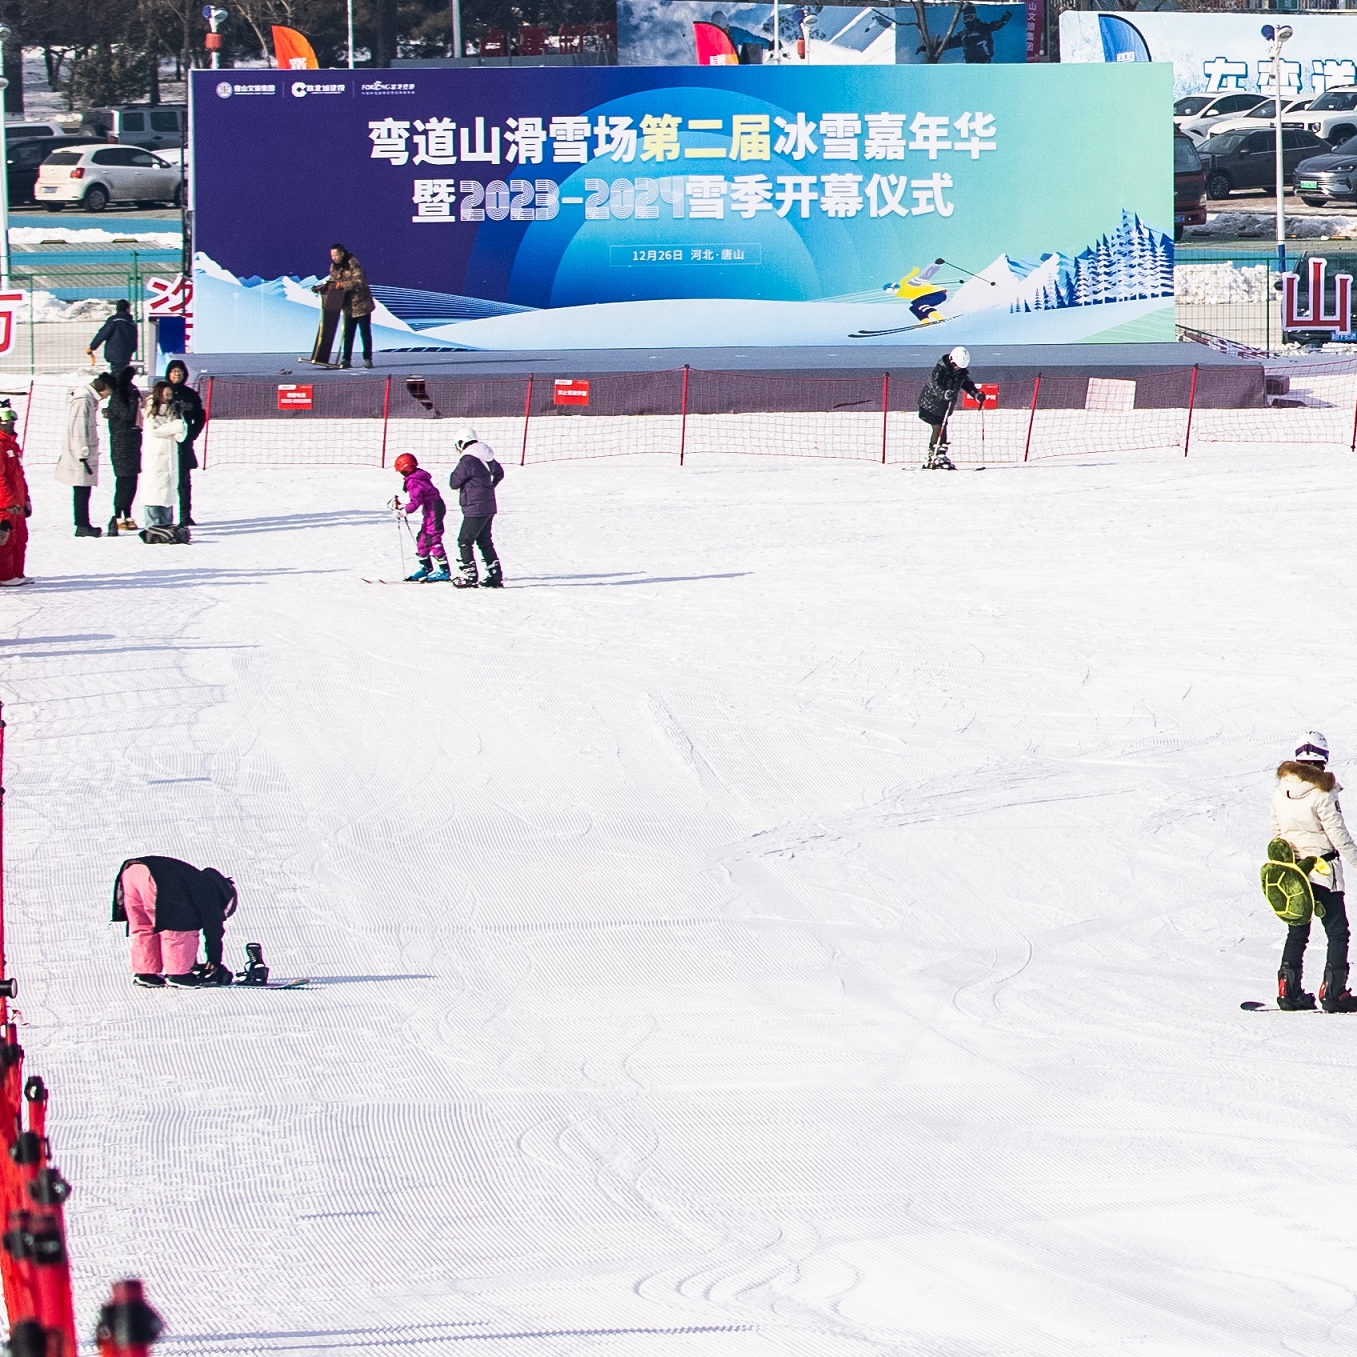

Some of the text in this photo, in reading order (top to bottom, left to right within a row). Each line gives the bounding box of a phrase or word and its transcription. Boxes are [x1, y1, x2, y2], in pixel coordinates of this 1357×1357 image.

[368, 112, 998, 166] 弯道山滑雪场第二届冰雪嘉年华
[411, 172, 955, 223] 暨2023-2024雪季开幕仪式
[632, 248, 745, 262] 12月26日 河北·唐山
